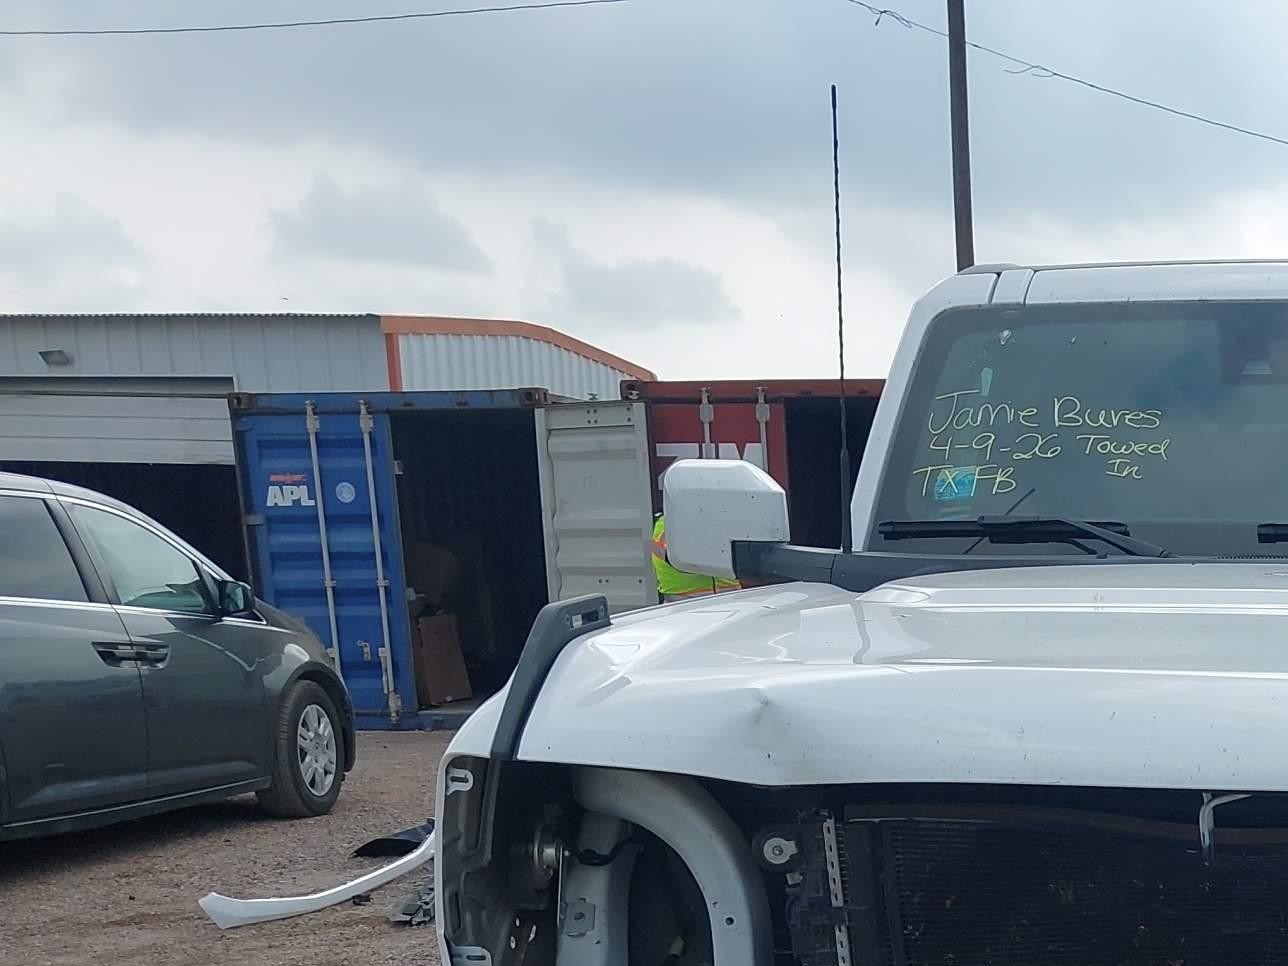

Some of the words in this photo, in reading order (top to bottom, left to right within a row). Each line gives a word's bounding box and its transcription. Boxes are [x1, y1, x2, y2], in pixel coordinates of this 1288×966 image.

[1053, 396, 1162, 428] Bures
[929, 433, 1062, 461] 4-9-26
[1076, 434, 1170, 460] Towed
[1106, 458, 1143, 480] In
[266, 485, 316, 507] APL
